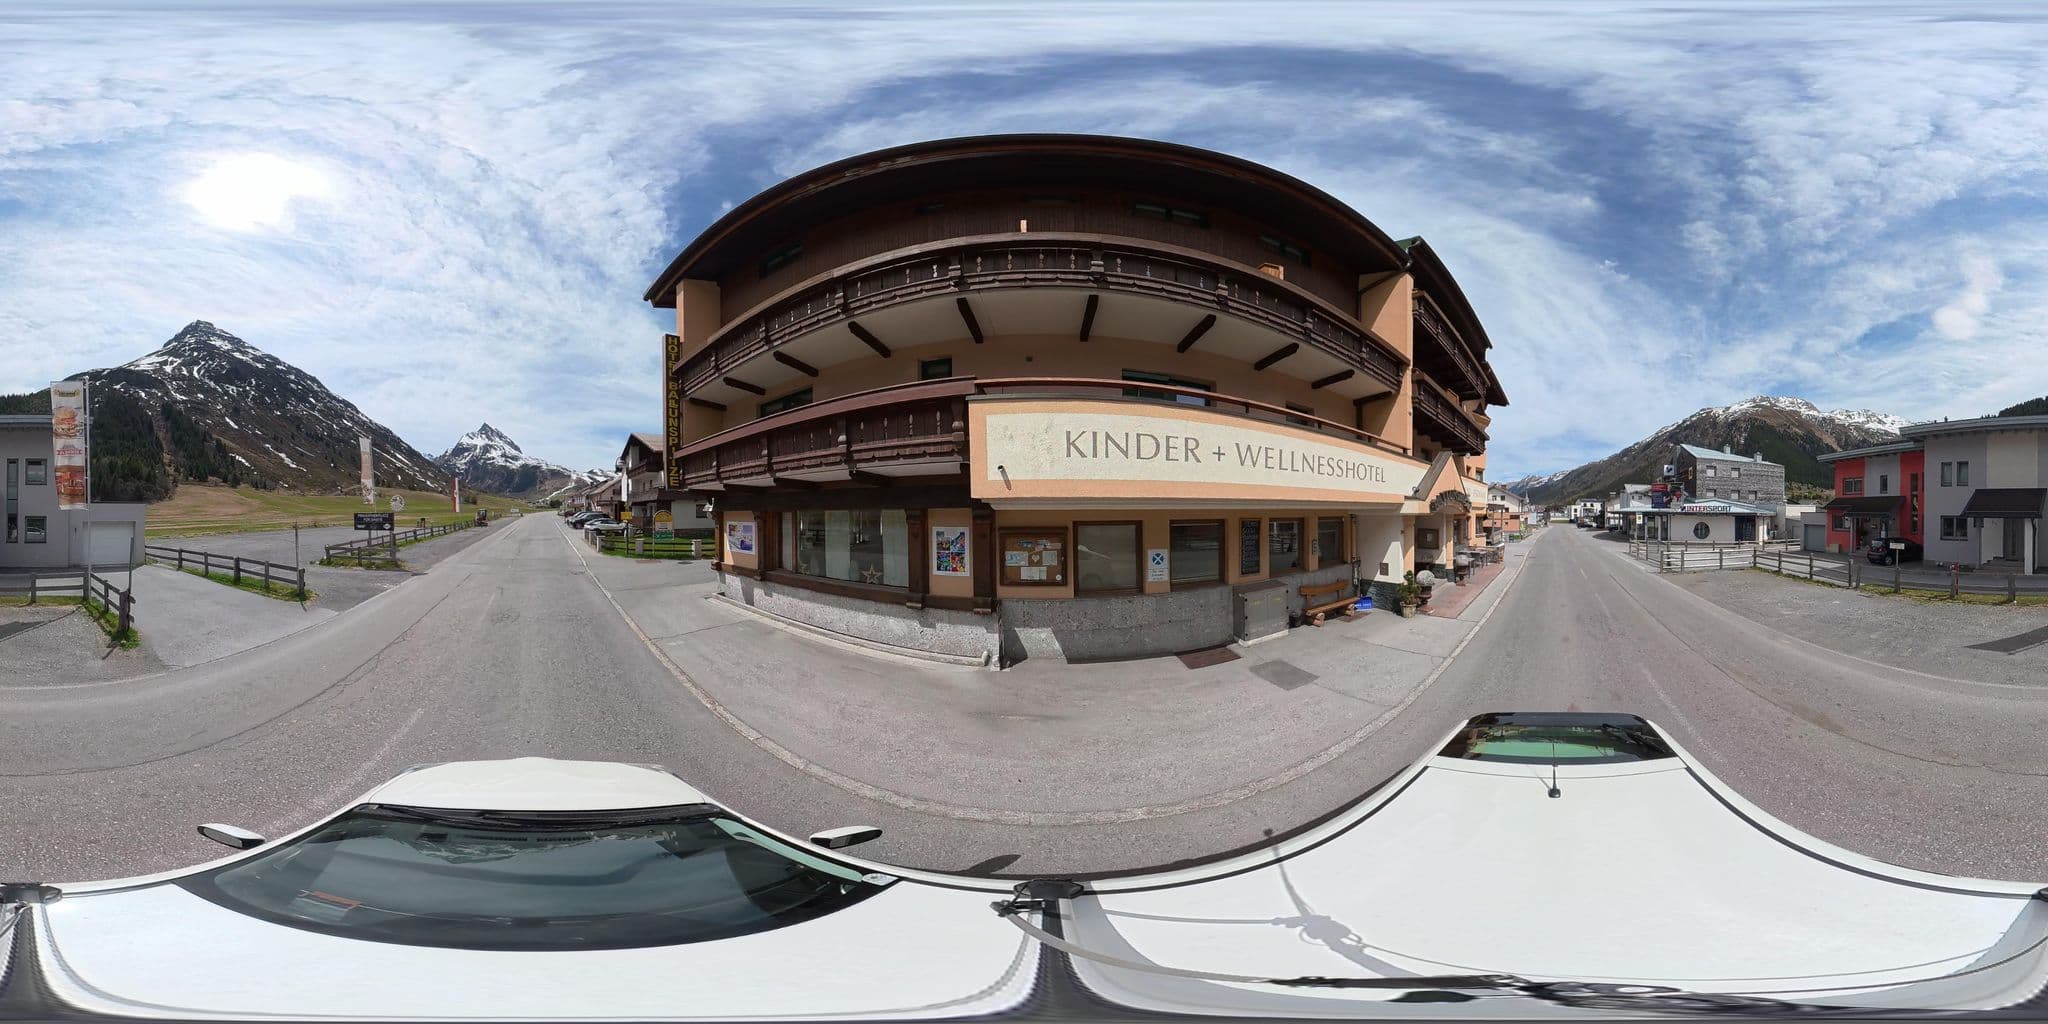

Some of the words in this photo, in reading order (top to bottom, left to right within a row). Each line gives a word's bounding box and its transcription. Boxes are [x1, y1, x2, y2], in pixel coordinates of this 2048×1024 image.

[1066, 430, 1202, 463] KINDER
[1212, 446, 1225, 461] +
[1235, 442, 1386, 483] WELLNESSHOTEL
